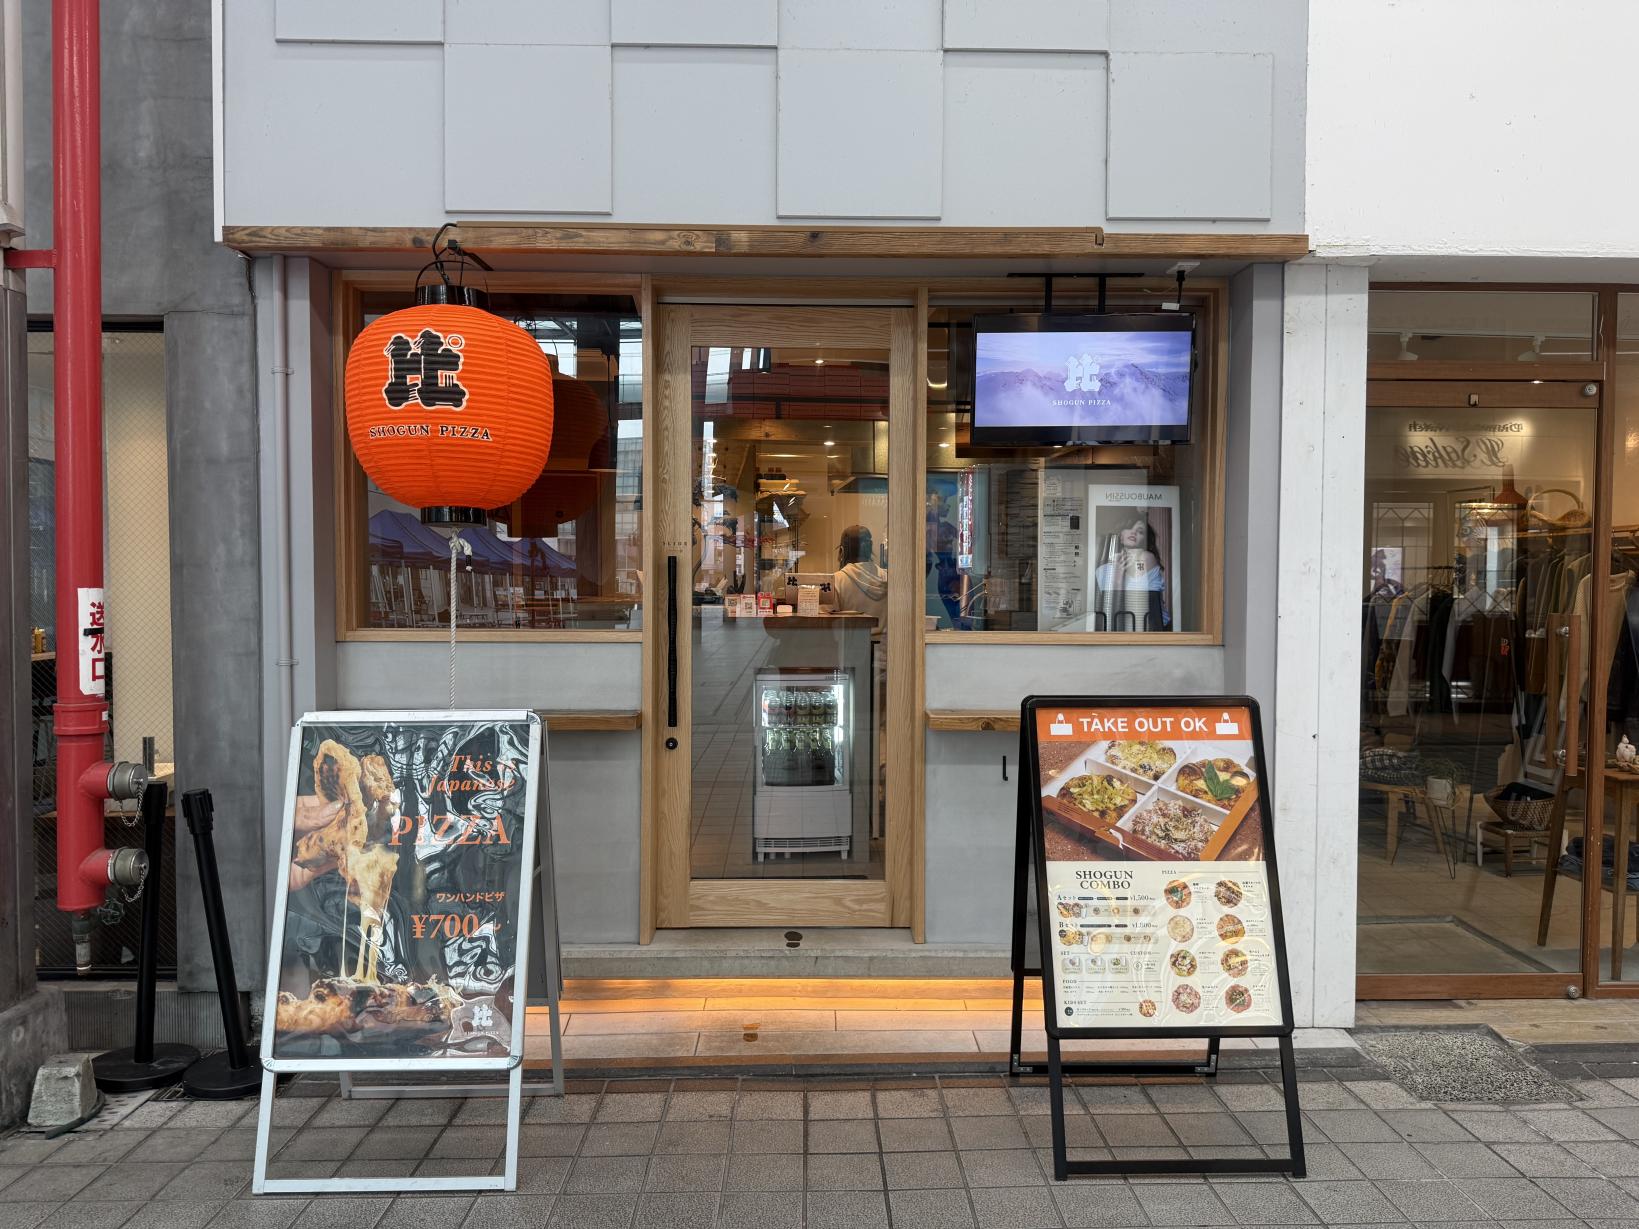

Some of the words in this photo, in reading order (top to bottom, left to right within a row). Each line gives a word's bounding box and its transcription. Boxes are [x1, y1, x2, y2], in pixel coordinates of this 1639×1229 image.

[369, 424, 431, 438] SHOGUN
[438, 424, 493, 440] PIZZA
[1079, 717, 1129, 732] TAKE
[1134, 717, 1174, 732] OUT
[1180, 717, 1208, 732] OK
[451, 754, 493, 773] This
[388, 814, 512, 846] PIZZA
[1075, 870, 1134, 880] SHOGUN
[1080, 880, 1131, 890] COMBO
